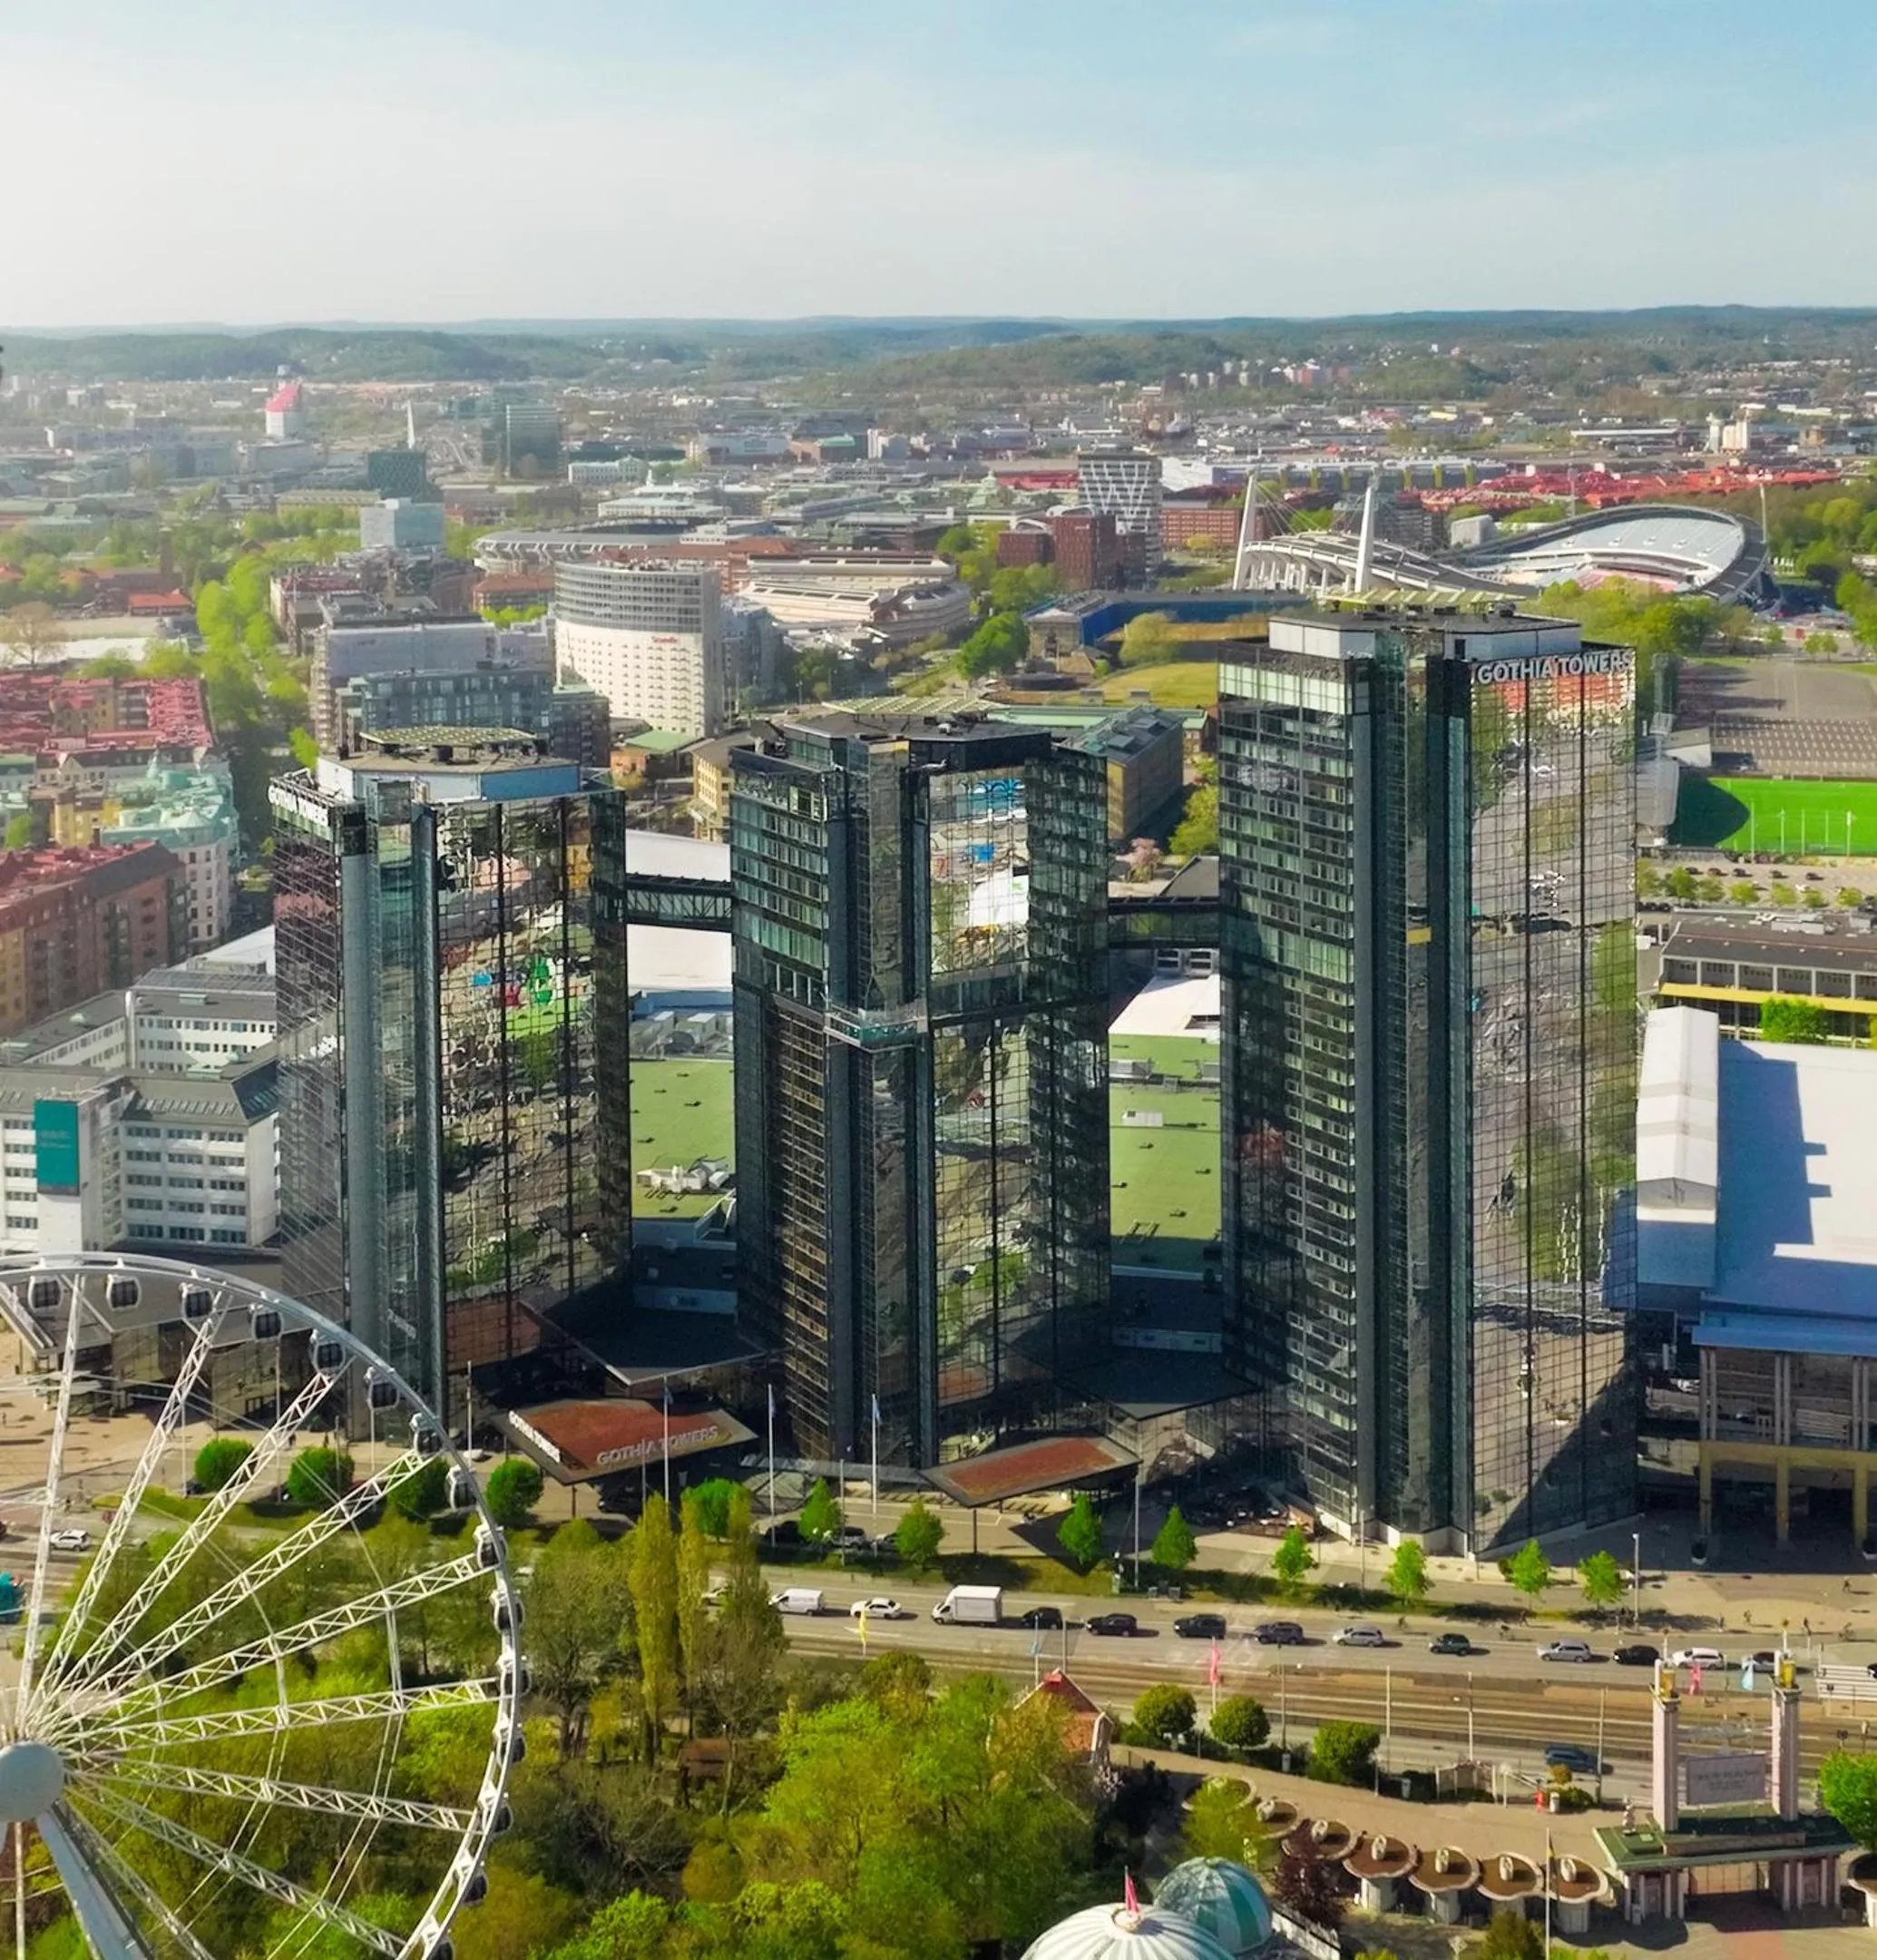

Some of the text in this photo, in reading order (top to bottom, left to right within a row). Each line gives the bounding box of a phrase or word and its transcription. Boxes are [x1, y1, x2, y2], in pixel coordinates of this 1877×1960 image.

[1477, 649, 1633, 684] GOTHIA TOWERS
[596, 1439, 659, 1465] GOTHA
